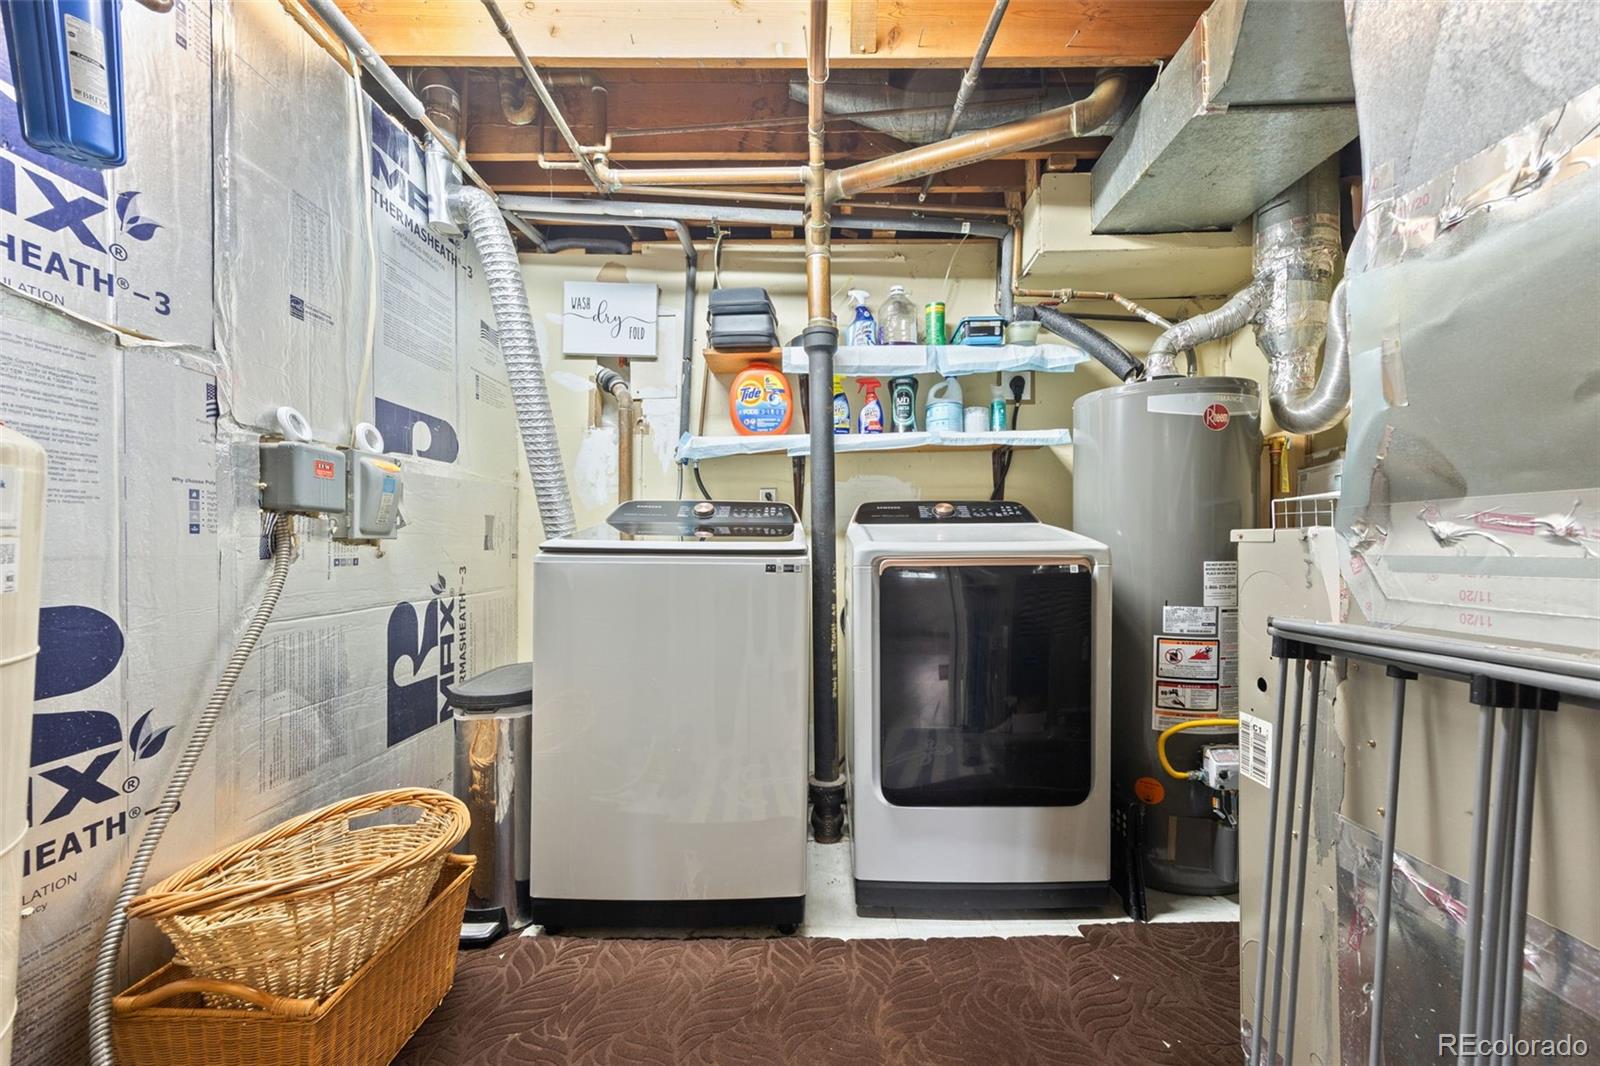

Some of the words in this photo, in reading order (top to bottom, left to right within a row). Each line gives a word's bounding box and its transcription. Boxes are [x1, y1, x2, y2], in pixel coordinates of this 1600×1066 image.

[571, 296, 591, 310] WASH
[592, 299, 622, 339] dry
[629, 326, 645, 340] FOLD
[740, 386, 762, 402] Tide
[1206, 403, 1228, 425] Rheem
[1252, 724, 1262, 734] C1
